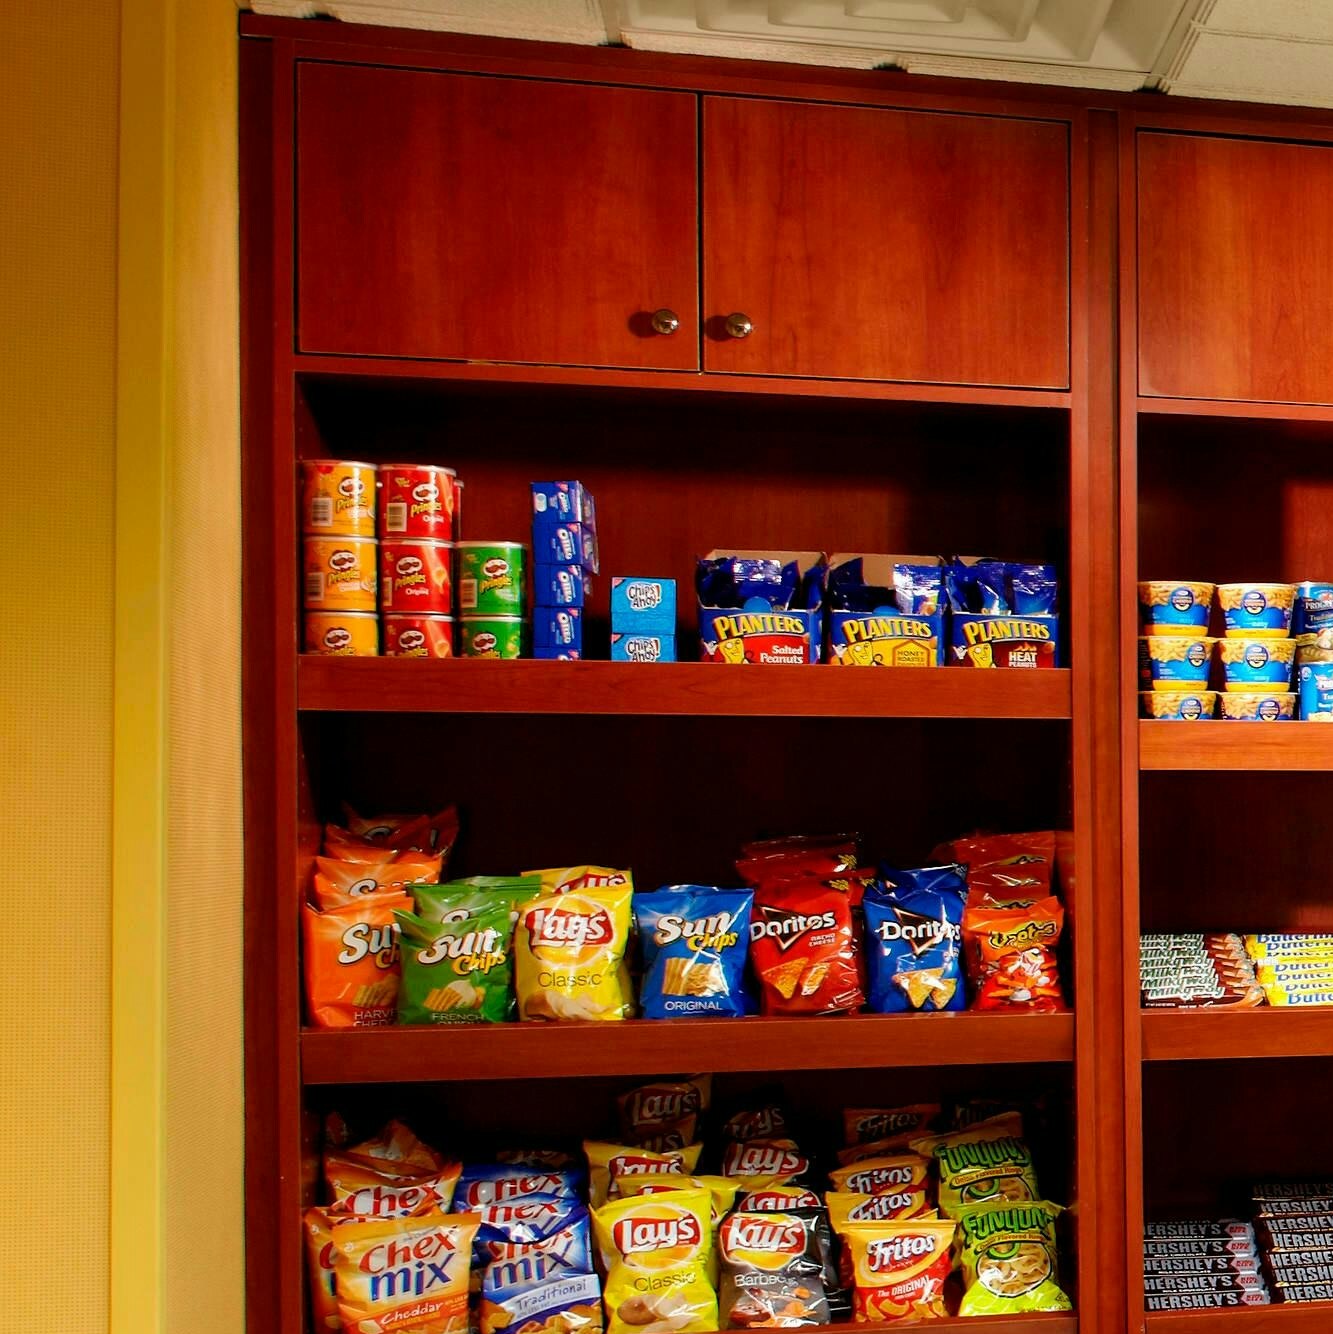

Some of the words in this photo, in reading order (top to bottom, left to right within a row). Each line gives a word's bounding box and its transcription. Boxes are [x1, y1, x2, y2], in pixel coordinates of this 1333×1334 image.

[713, 615, 805, 641] PLANTERS
[842, 617, 932, 641] PLANTERS
[962, 619, 1050, 644] PLANTERS
[760, 653, 804, 664] Peanuts
[771, 645, 804, 655] Salted
[896, 650, 926, 658] HONEY
[1008, 651, 1037, 663] HEAT
[530, 906, 607, 956] Lay's
[656, 910, 733, 946] Sun
[748, 910, 836, 941] Doritos
[881, 920, 962, 947] Doritos
[417, 929, 500, 965] Sun
[687, 929, 739, 953] Chips
[452, 951, 507, 976] Chips
[537, 971, 603, 988] Classic
[353, 1010, 398, 1021] HARV
[431, 1011, 486, 1022] FRENCH
[664, 1000, 723, 1011] ORIGINAL
[728, 1143, 801, 1177] Lay's
[847, 1165, 914, 1194] Fritos
[345, 1183, 443, 1217] Chex
[848, 1190, 914, 1222] Fritos
[622, 1214, 698, 1253] Lay's
[726, 1215, 804, 1254] Lay's
[359, 1224, 458, 1275] Chex
[865, 1231, 936, 1272] Fritos
[491, 1241, 575, 1291] mix
[1143, 1257, 1229, 1271] HERSHEY'S
[369, 1252, 455, 1304] mix
[633, 1271, 698, 1292] Classic
[891, 1275, 931, 1297] ORIGINAL
[1144, 1275, 1233, 1290] HERSHEY'S
[513, 1278, 587, 1312] Traditional
[1148, 1292, 1239, 1310] HERSHEY'S
[380, 1299, 446, 1325] Cheddar
